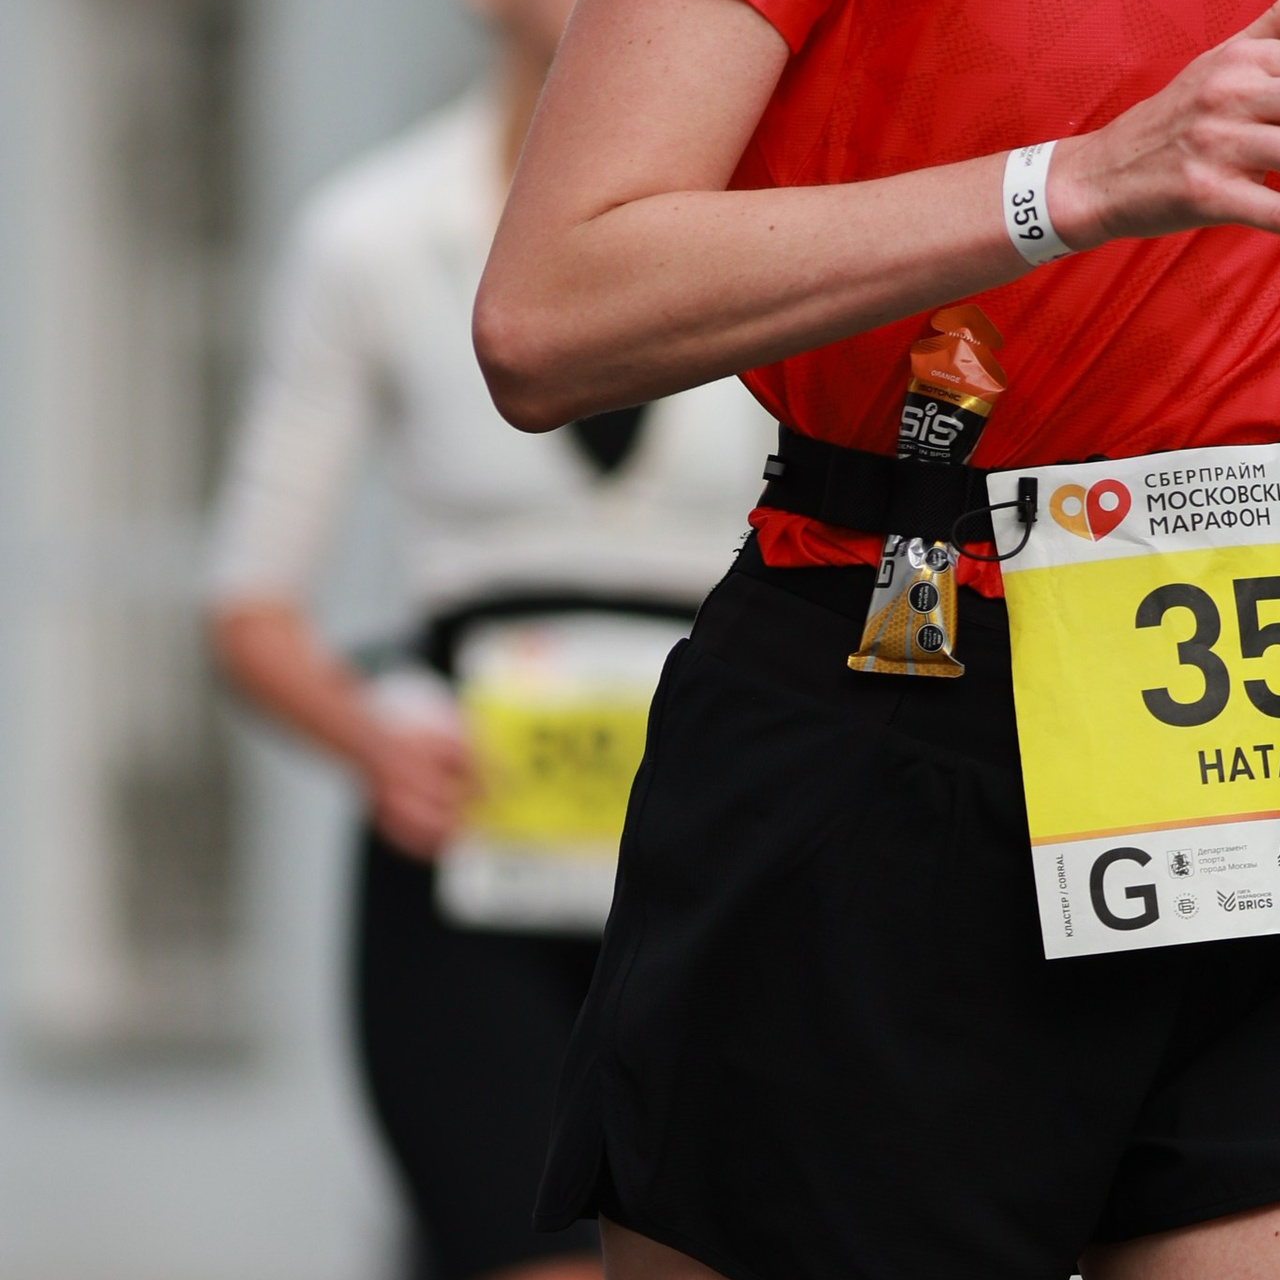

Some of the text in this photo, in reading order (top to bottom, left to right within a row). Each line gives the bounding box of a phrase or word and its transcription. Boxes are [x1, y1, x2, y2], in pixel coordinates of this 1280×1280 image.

[1012, 189, 1044, 240] 359
[930, 369, 961, 384] ORANGE
[930, 451, 951, 459] SPO
[1144, 462, 1266, 488] СБЕРПРАЙМ
[1149, 507, 1271, 536] МАРАФОН
[1197, 844, 1248, 856] Департамент
[1198, 856, 1225, 866] спорта
[1200, 862, 1258, 874] города Москвы
[1056, 854, 1067, 889] CORRAL
[1089, 846, 1160, 931] G
[1238, 898, 1274, 911] BRICS
[1061, 897, 1074, 937] КЛАСТЕР
